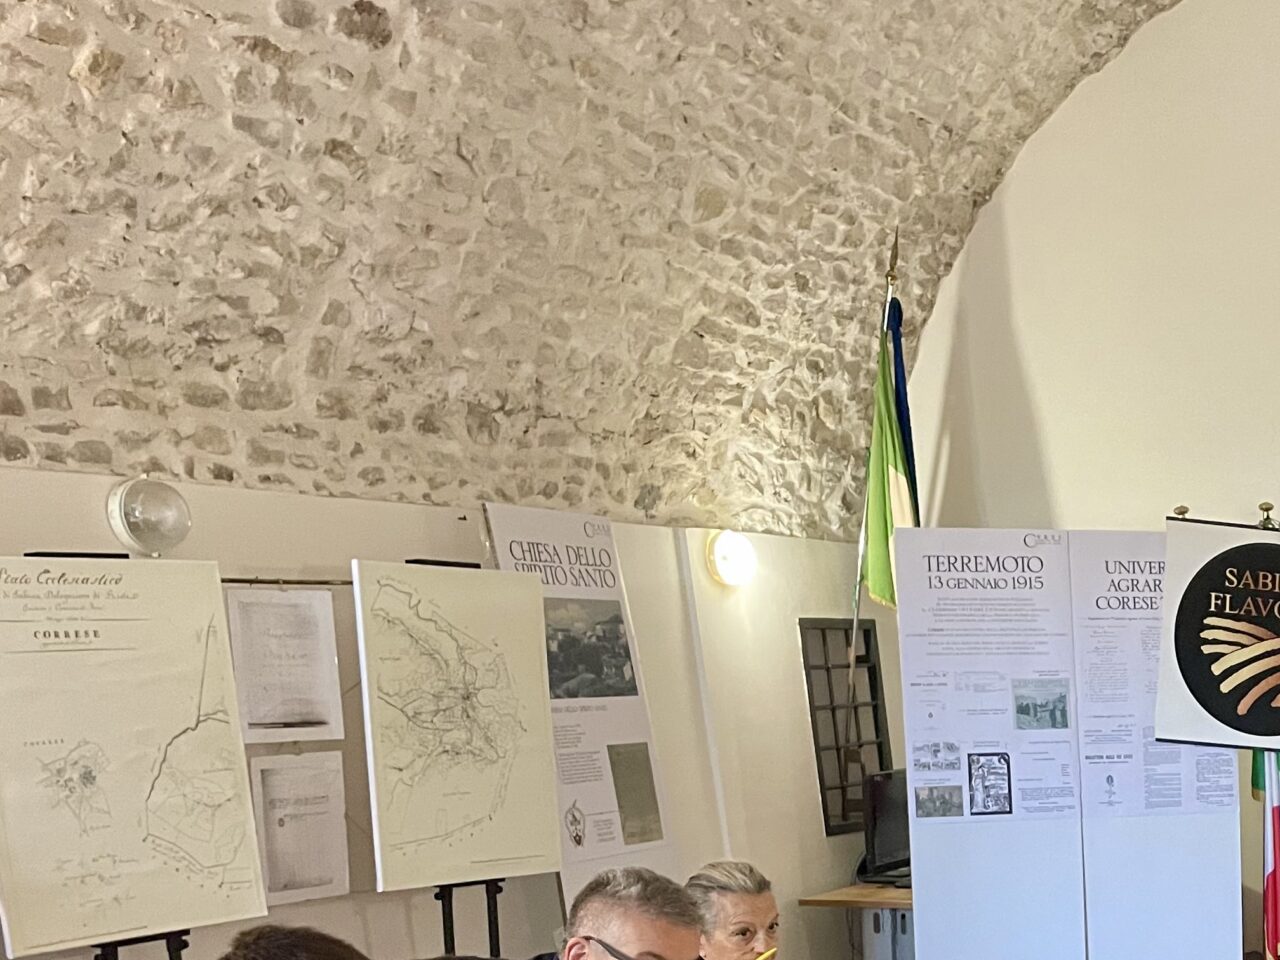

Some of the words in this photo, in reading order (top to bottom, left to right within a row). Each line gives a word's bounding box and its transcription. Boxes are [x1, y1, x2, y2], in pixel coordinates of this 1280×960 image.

[509, 540, 562, 564] CHIESA
[565, 544, 612, 568] DELLO
[922, 555, 1044, 573] TERREMOTO
[569, 566, 616, 588] SANTO
[927, 575, 944, 590] 13
[946, 577, 1008, 590] GENNAIO
[1011, 575, 1044, 590] 1915
[34, 629, 101, 639] CORRESE
